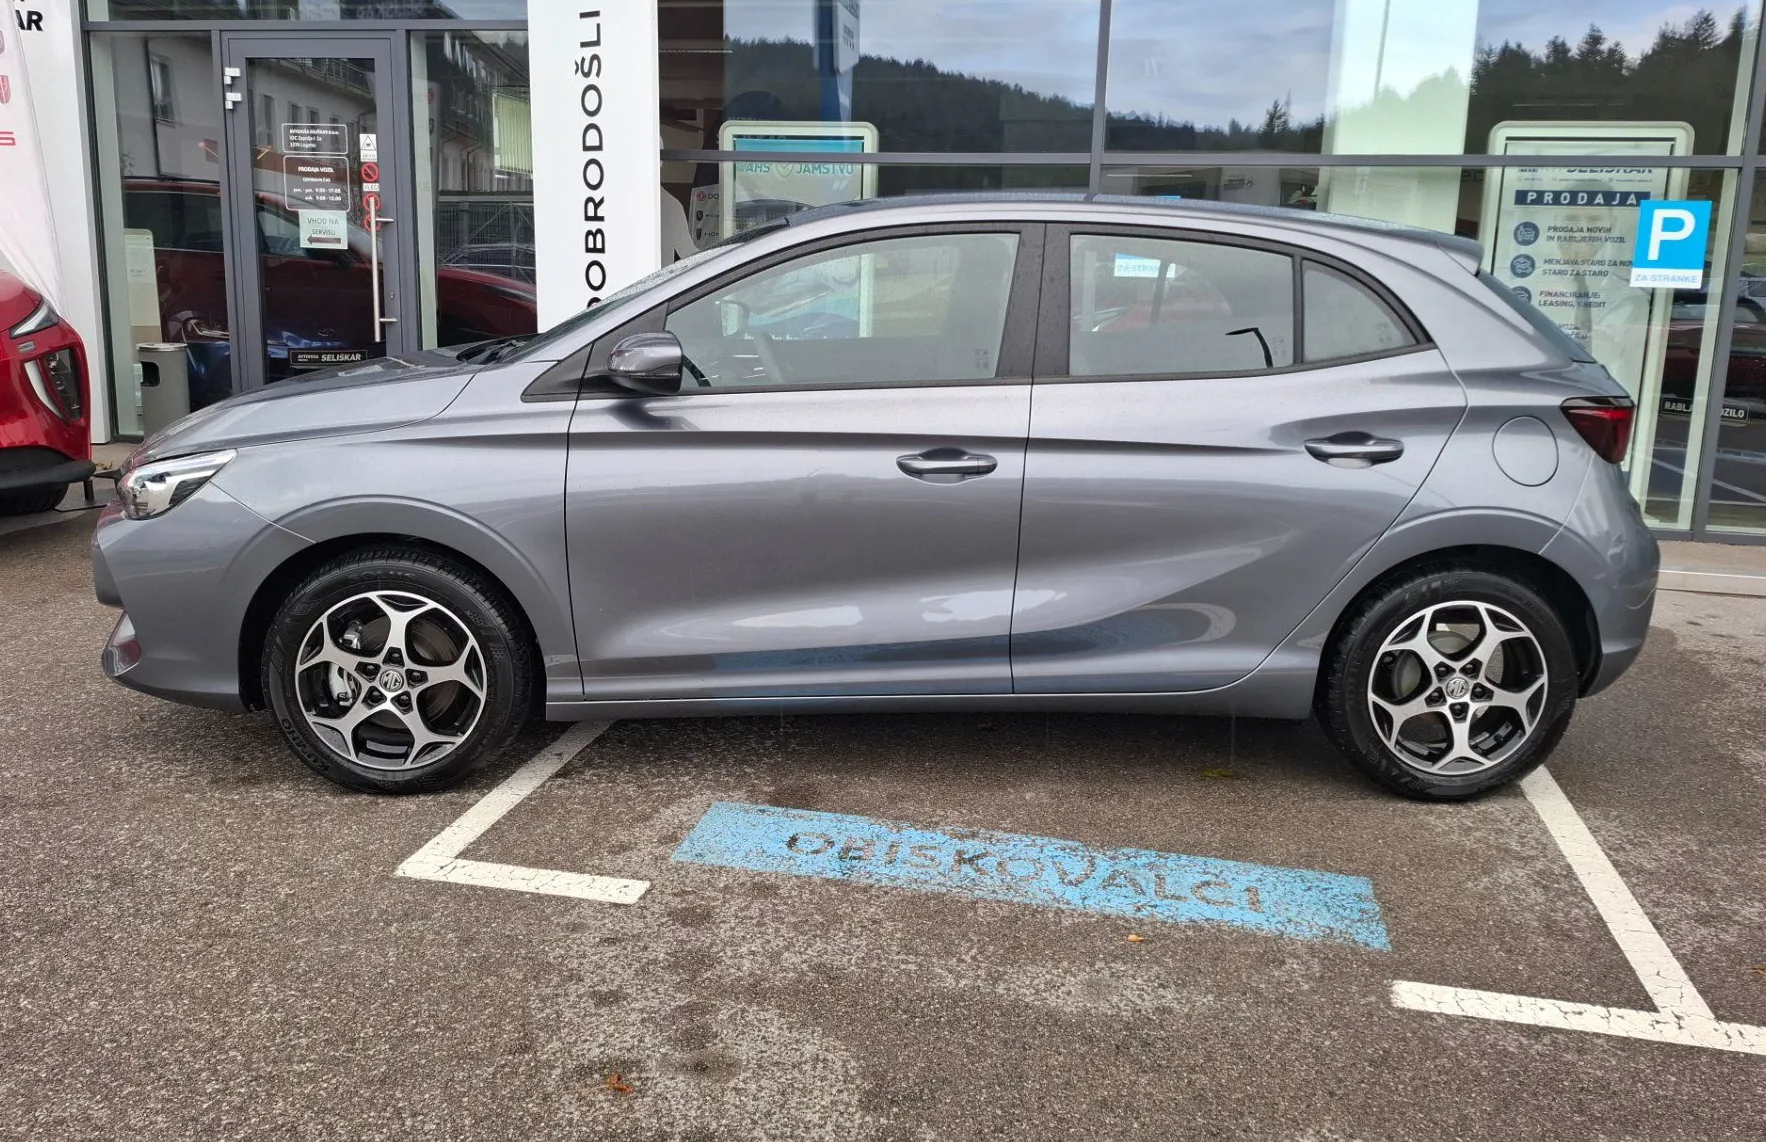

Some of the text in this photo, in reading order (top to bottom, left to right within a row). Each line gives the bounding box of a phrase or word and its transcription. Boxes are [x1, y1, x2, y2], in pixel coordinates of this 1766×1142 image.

[575, 10, 606, 308] OBRODOŠLI
[1526, 192, 1637, 205] PRODAJA
[307, 217, 339, 225] VHOD NA
[1547, 225, 1584, 233] PRODAJA
[1648, 208, 1696, 261] P
[1635, 274, 1698, 284] ZA STRANKE
[380, 671, 403, 691] MG
[785, 832, 1264, 913] OBISKOVALCI
